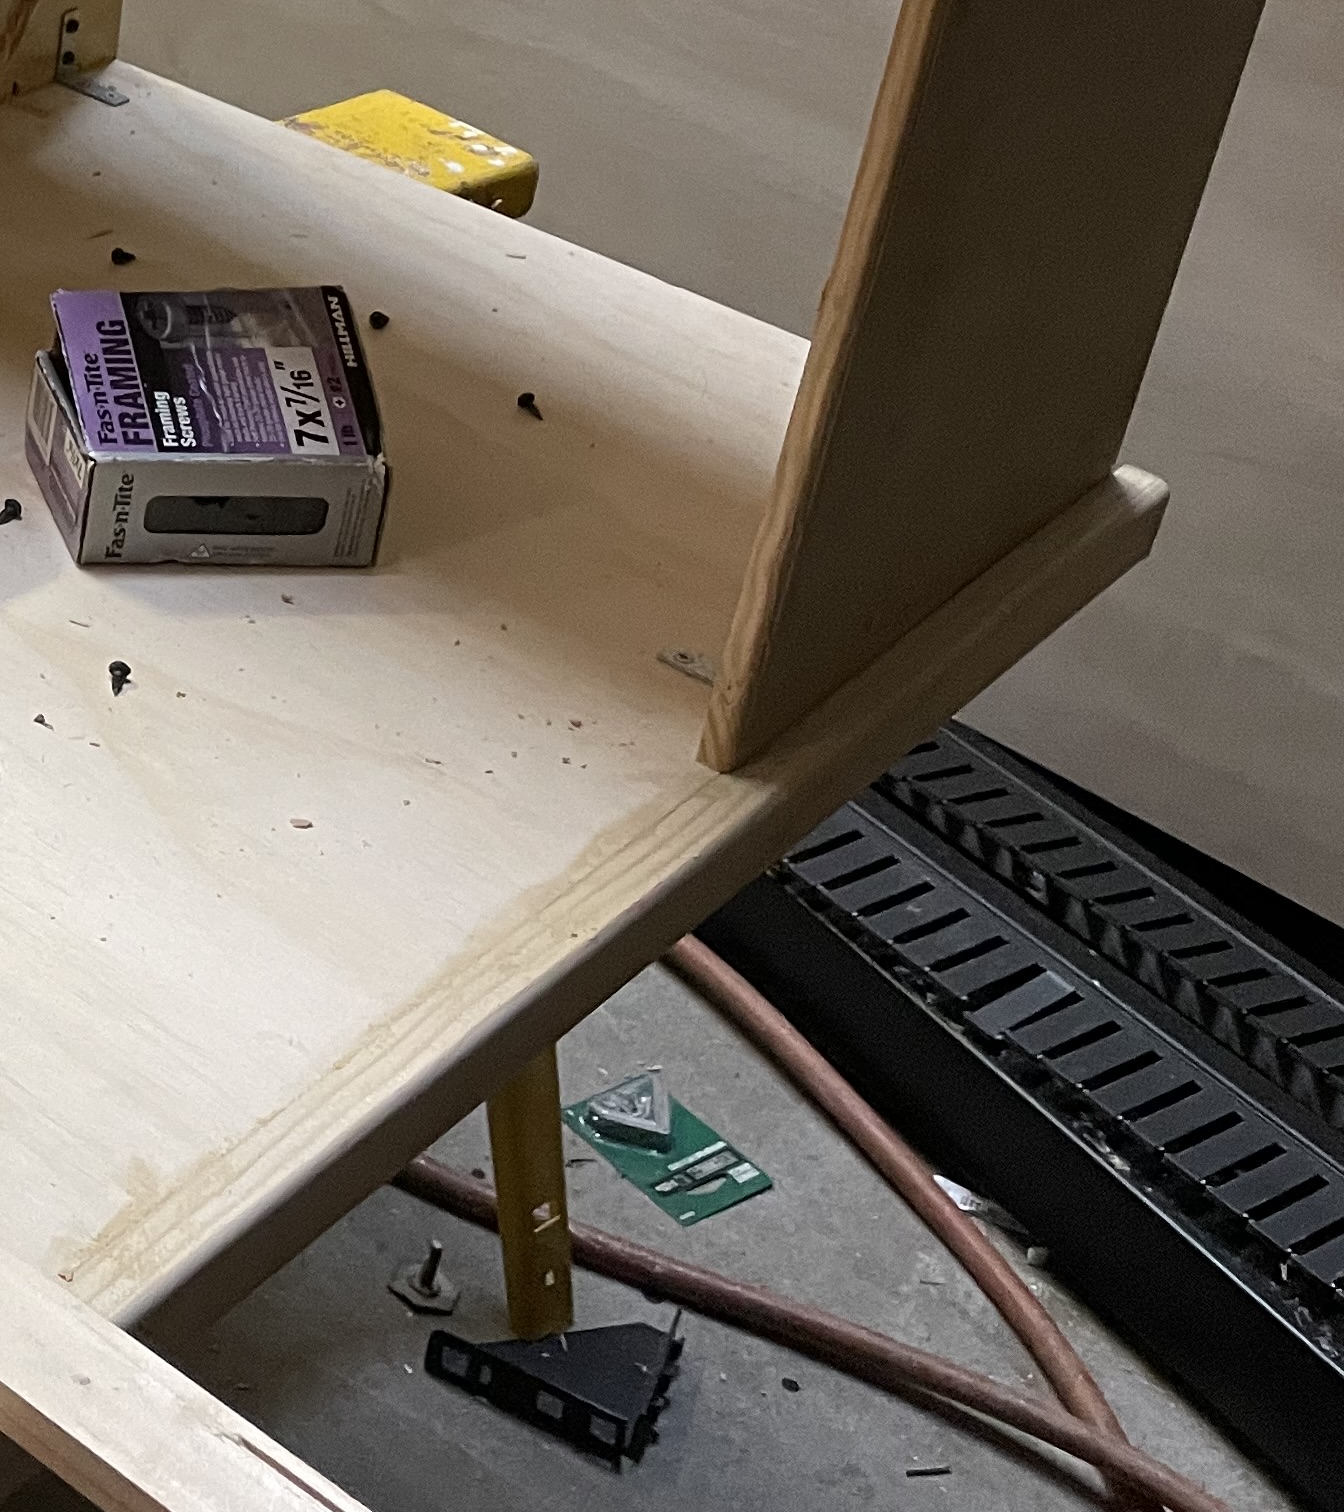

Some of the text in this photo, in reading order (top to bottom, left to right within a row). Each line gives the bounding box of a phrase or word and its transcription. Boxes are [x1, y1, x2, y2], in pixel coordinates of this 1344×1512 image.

[327, 294, 359, 368] HILLMAN
[95, 318, 154, 449] FRAMING
[153, 390, 180, 448] Framing
[172, 396, 197, 448] Screws
